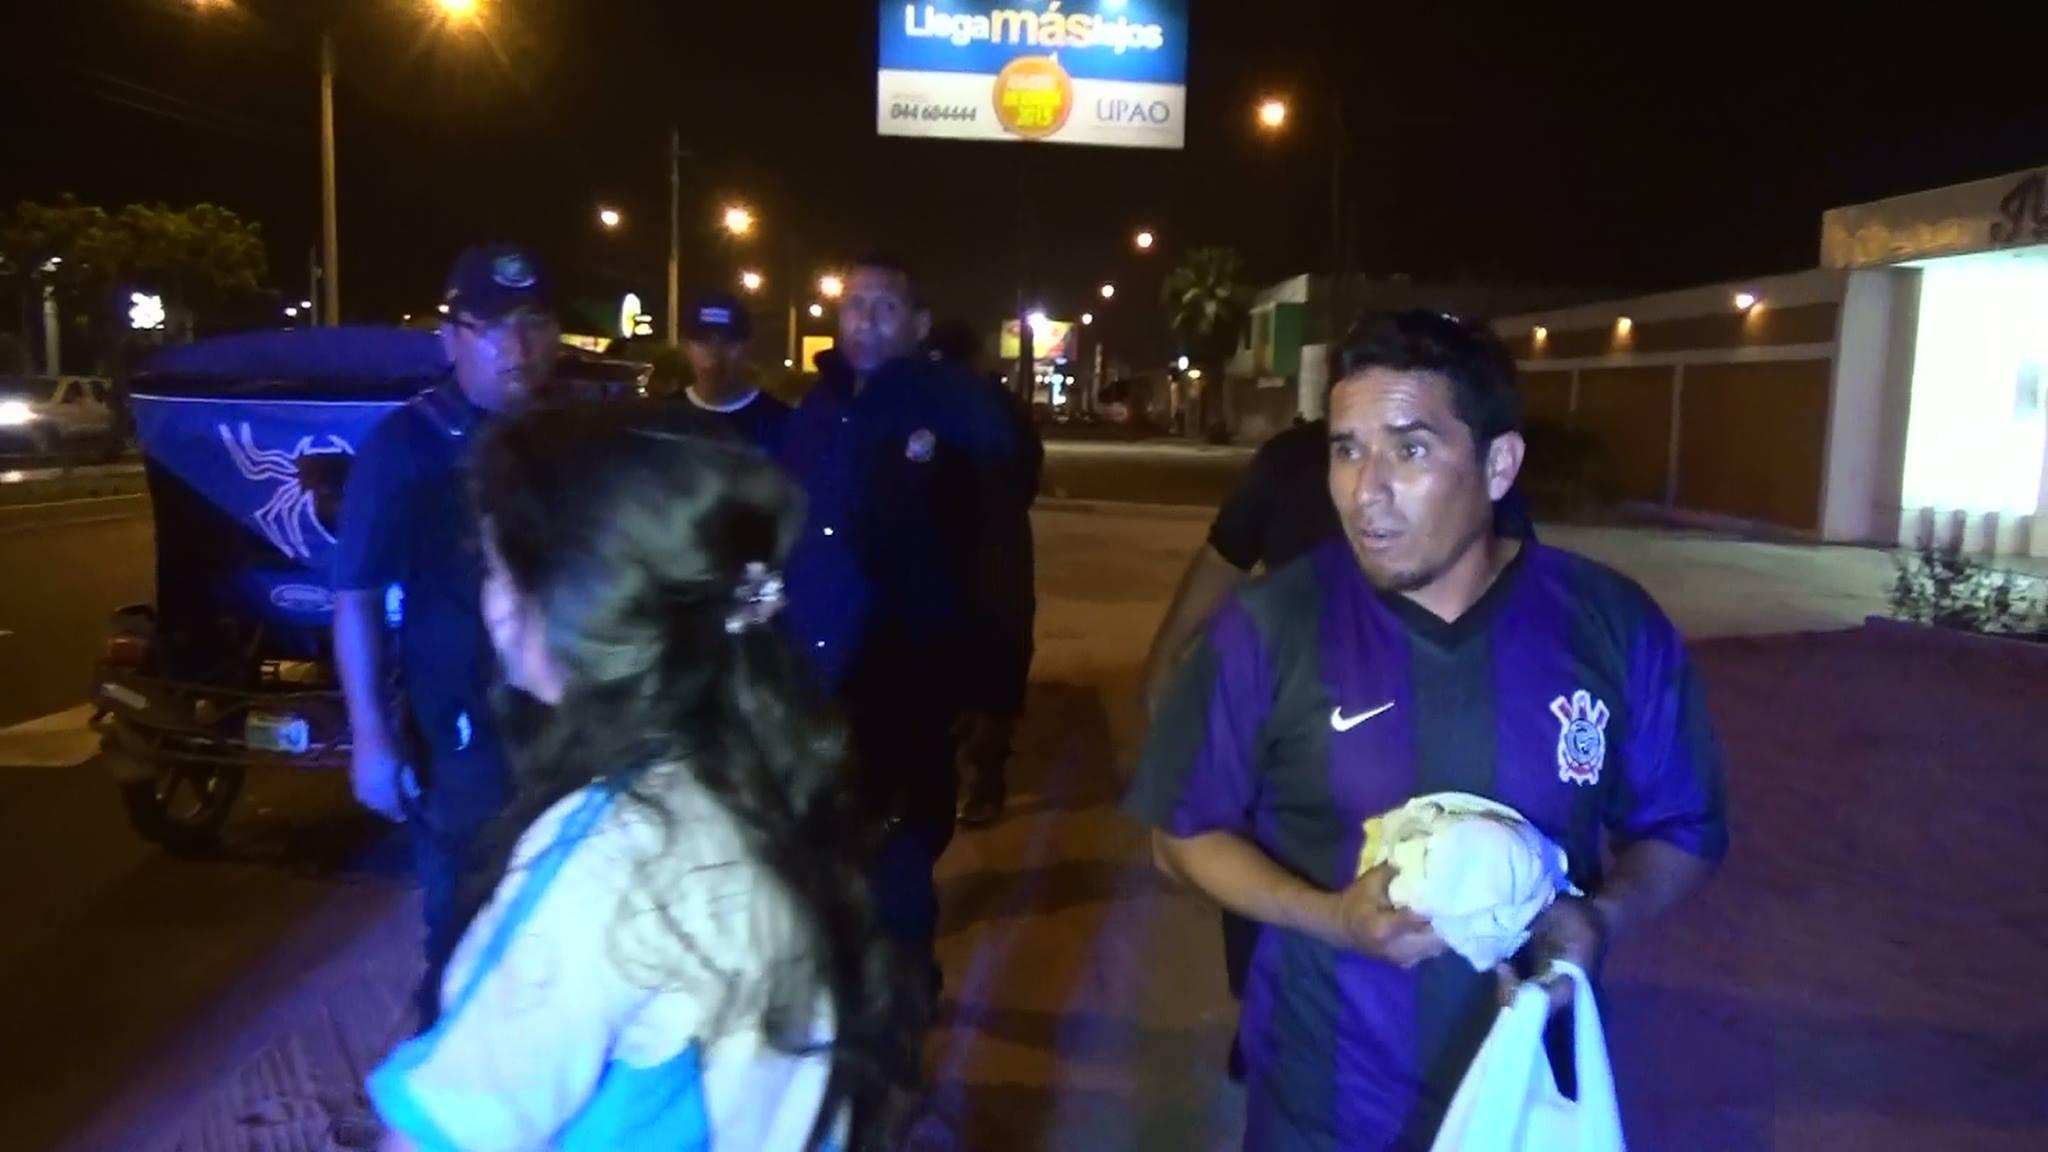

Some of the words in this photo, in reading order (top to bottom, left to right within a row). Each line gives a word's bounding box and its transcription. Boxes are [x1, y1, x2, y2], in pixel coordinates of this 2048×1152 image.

[904, 5, 990, 46] Llega
[990, 3, 1093, 48] más
[1093, 13, 1164, 55] lejos
[1096, 99, 1170, 124] UPAO
